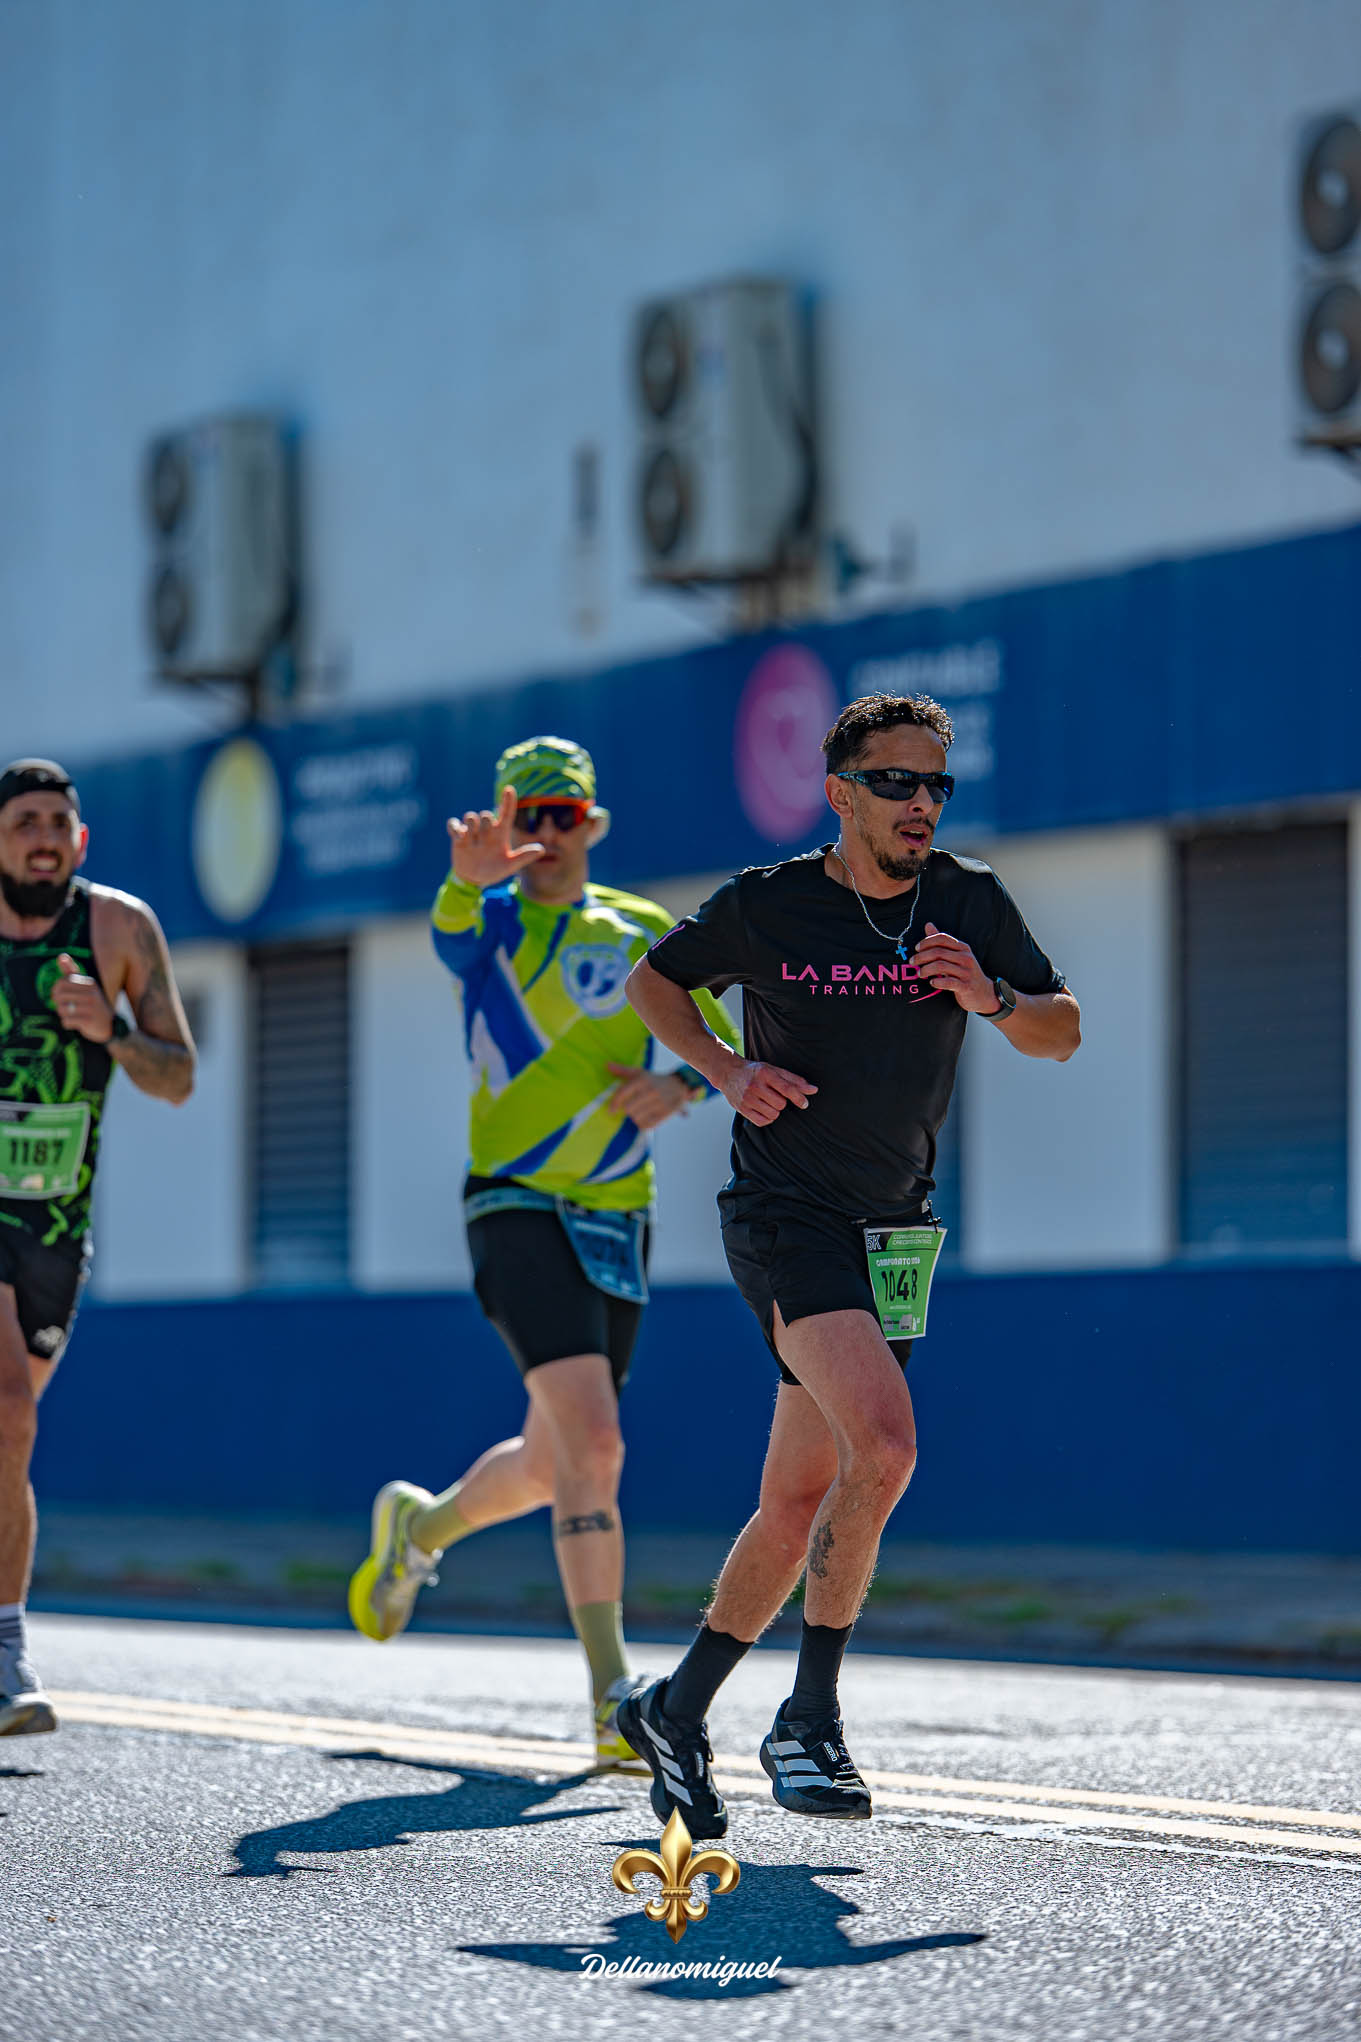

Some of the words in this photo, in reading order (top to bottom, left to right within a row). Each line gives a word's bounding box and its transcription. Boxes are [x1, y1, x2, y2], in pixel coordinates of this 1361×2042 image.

[781, 963, 820, 981] LA
[831, 964, 945, 982] BAND
[809, 984, 920, 996] TRAINING
[9, 1138, 64, 1166] 1187
[881, 1268, 918, 1303] 1048
